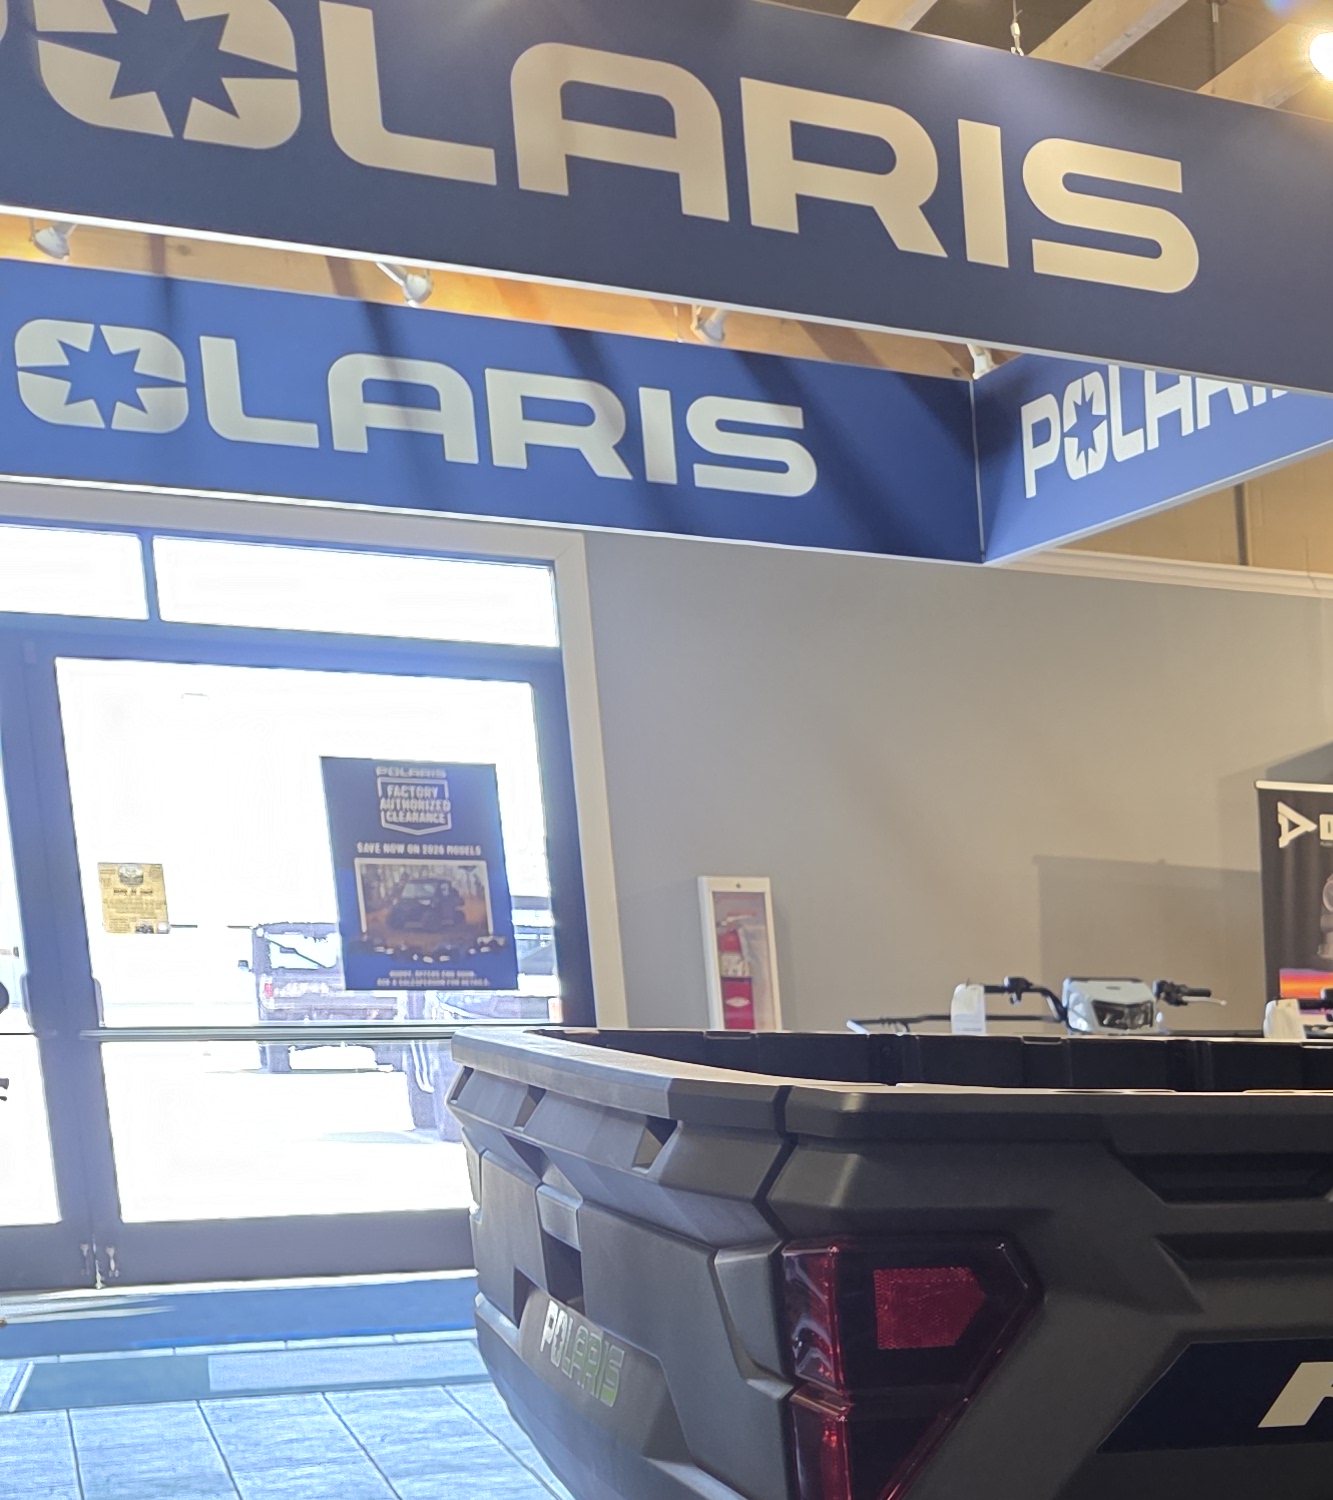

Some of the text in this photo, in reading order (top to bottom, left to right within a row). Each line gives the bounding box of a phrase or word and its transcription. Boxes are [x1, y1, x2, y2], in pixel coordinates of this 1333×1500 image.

[0, 0, 1199, 293] OLARIS
[14, 317, 818, 498] OLARIS
[375, 766, 447, 778] POLARIS
[387, 785, 439, 799] FACTORY
[380, 797, 451, 812] AUTHORIZED
[386, 811, 446, 824] CLEARANCE
[356, 842, 381, 854] SAVE
[383, 843, 405, 855] NOW
[540, 1299, 625, 1408] POLARIS
